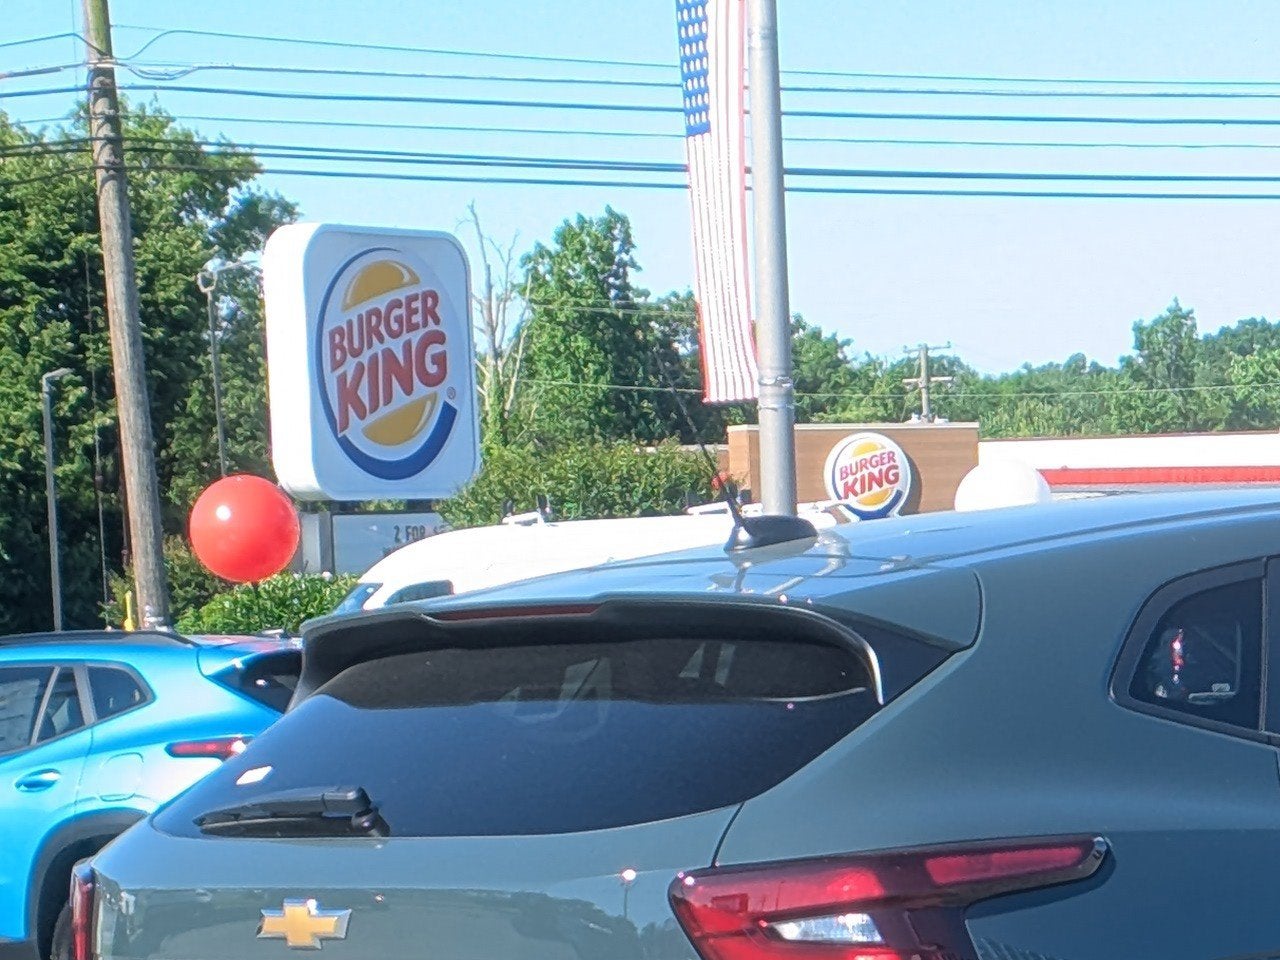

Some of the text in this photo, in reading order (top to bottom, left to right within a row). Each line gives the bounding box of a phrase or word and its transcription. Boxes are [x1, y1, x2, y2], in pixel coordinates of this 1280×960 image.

[328, 289, 441, 373] BURGER
[335, 329, 448, 434] KING
[839, 450, 897, 481] BURGER
[843, 464, 900, 500] KING
[393, 524, 401, 543] 2
[405, 525, 426, 541] FOR
